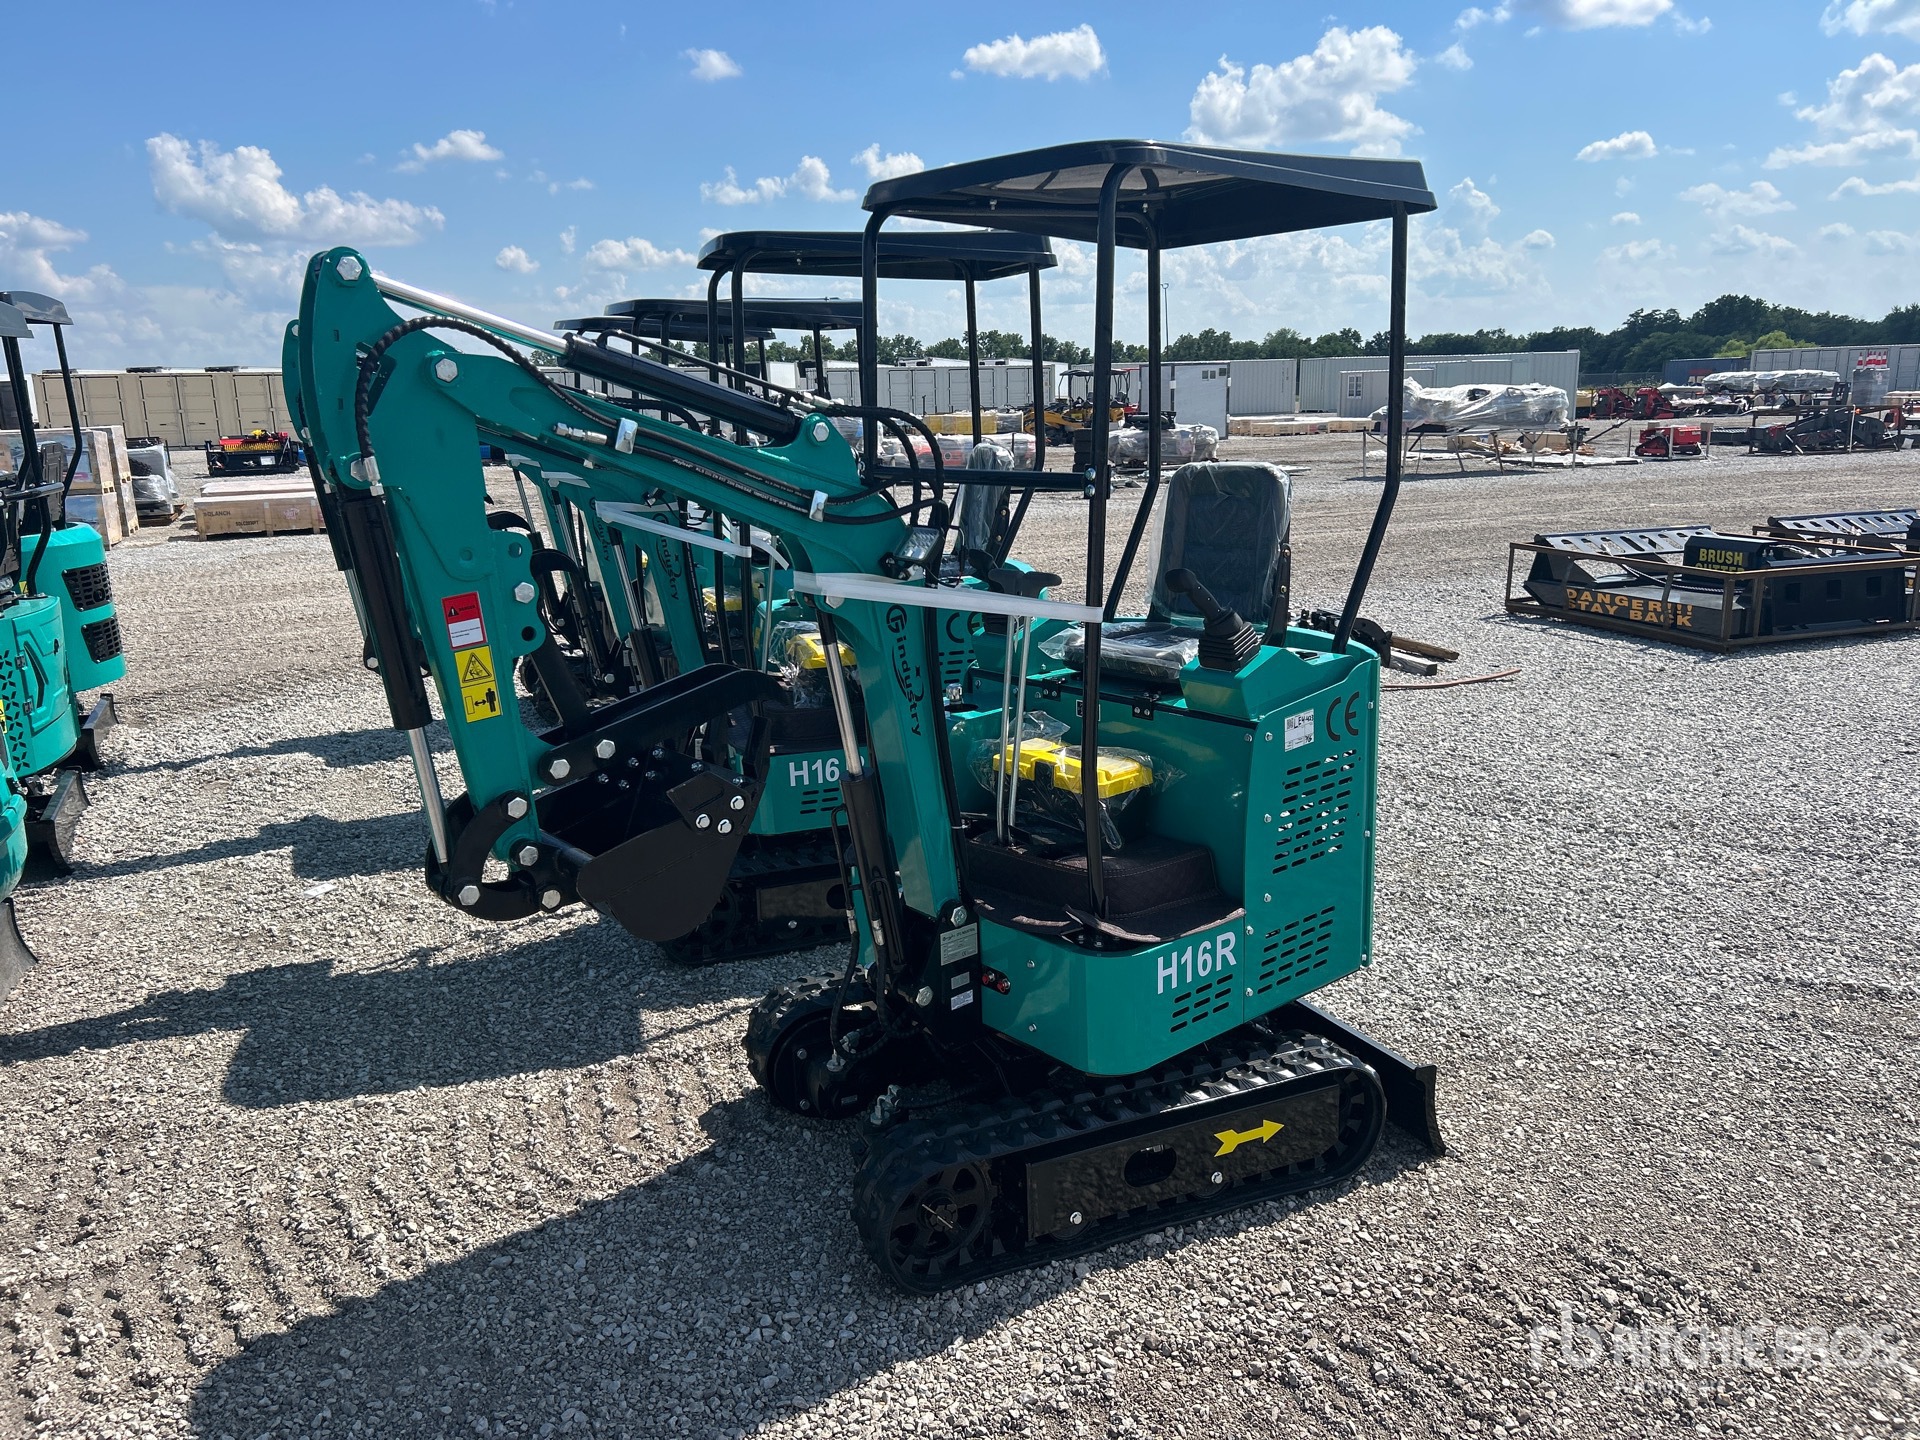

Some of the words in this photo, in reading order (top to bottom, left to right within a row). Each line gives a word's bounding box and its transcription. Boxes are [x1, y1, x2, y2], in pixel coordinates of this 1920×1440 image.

[1699, 548, 1743, 566] BRUSH
[1566, 588, 1693, 615] DANGER!!!
[1326, 691, 1359, 742] CE
[789, 756, 864, 787] H16
[1157, 931, 1237, 995] H16R
